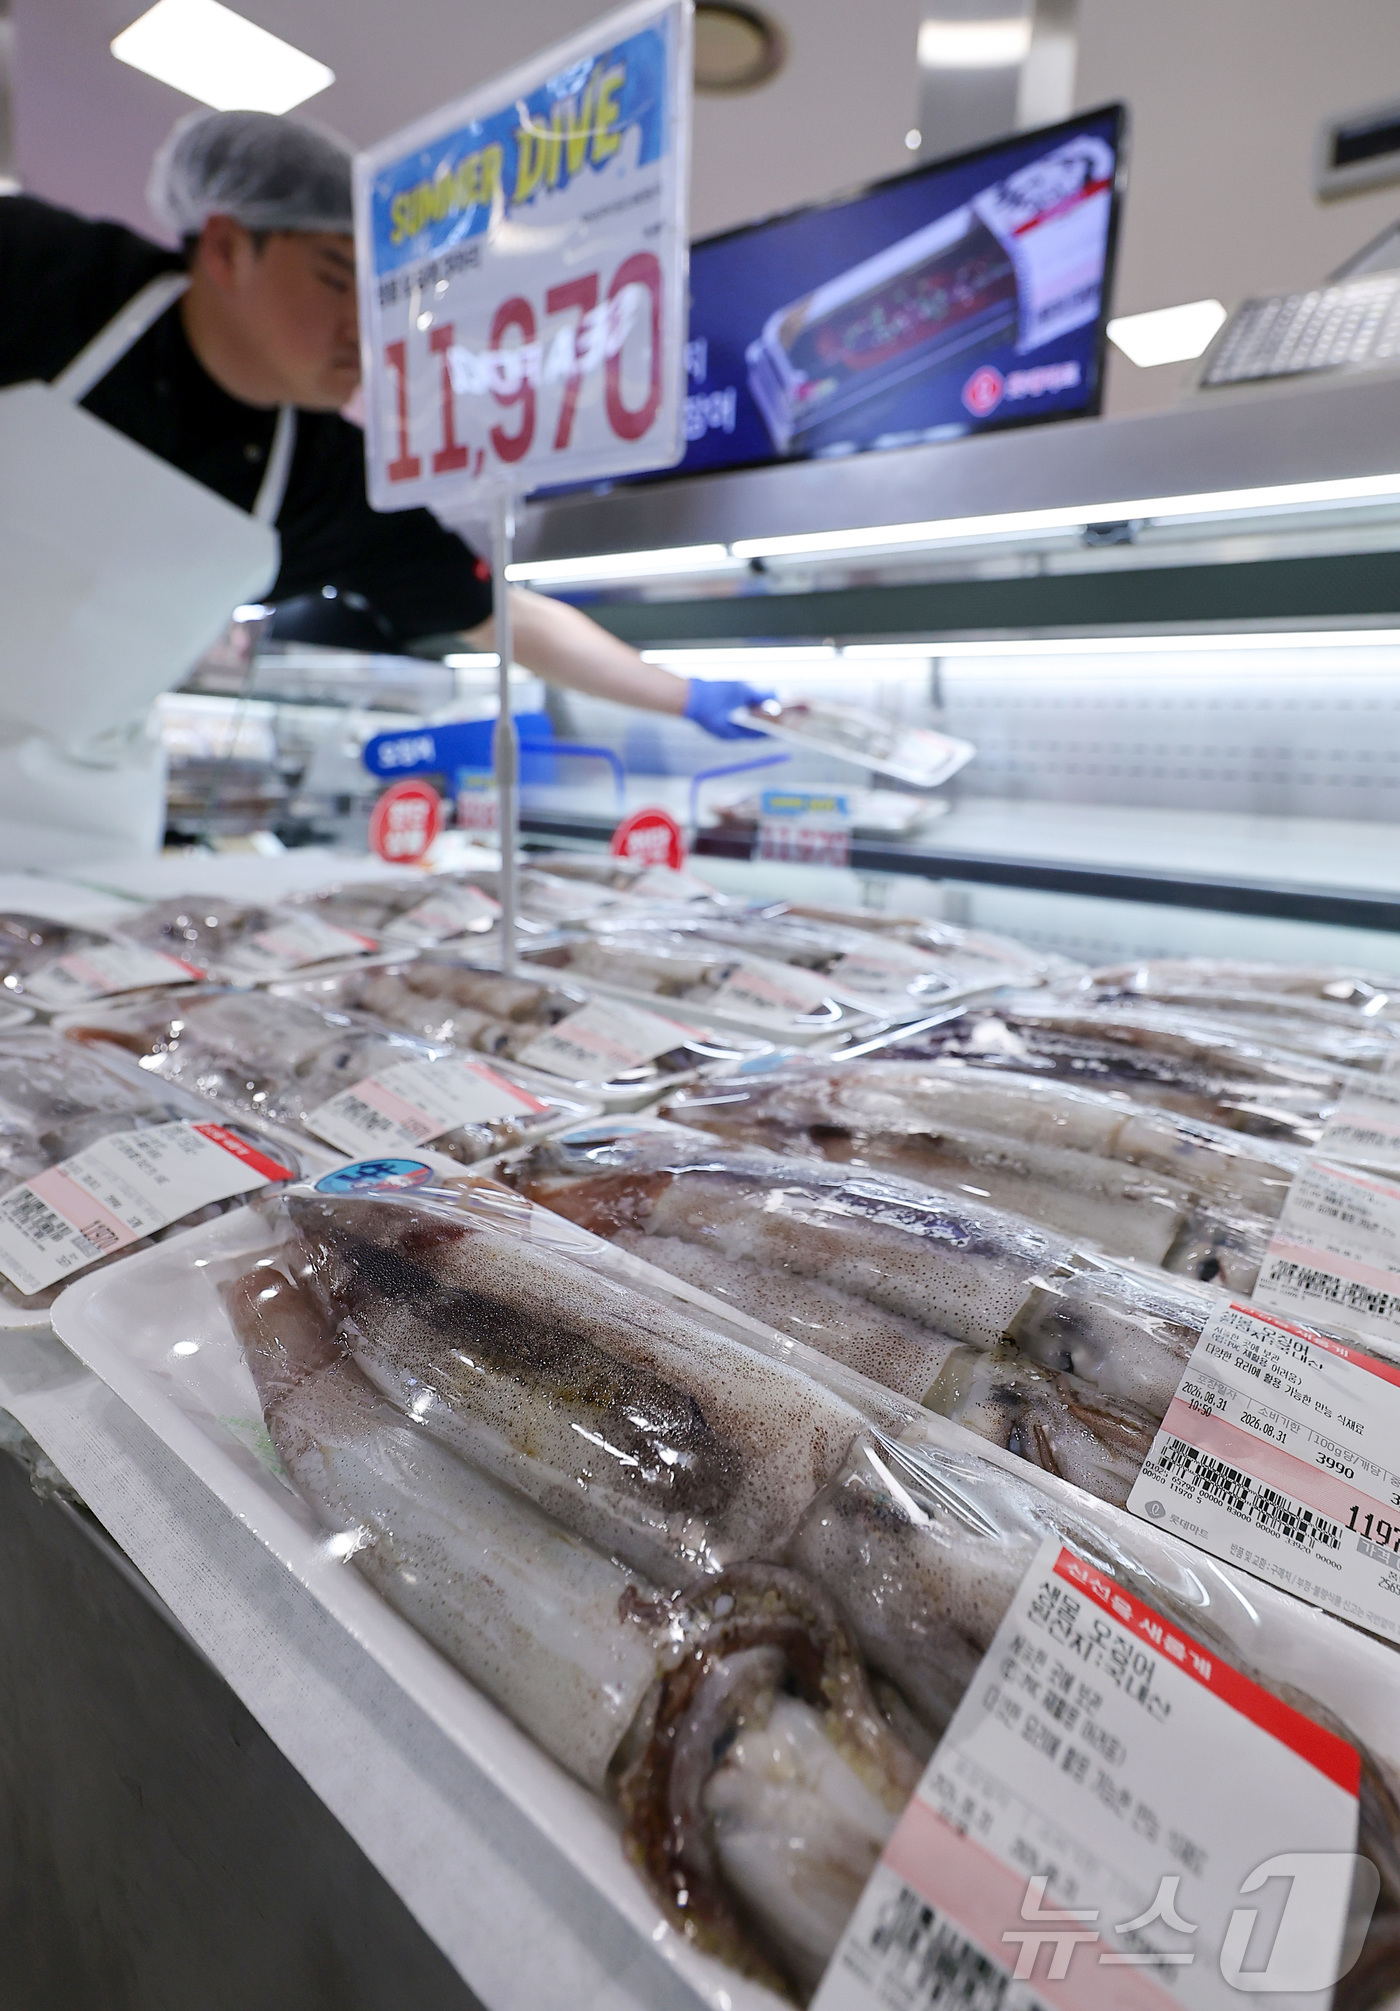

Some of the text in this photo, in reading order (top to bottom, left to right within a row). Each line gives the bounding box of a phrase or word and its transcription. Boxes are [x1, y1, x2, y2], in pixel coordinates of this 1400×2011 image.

[390, 62, 627, 246] SUMMER DIVE
[385, 251, 662, 483] 11,970
[1187, 1398, 1213, 1418] 10:50
[1205, 1342, 1365, 1437] 다양한 요리에 활용 가능한 만능 식재료
[1242, 1349, 1268, 1368] 재활용
[1271, 1363, 1303, 1386] 어려움)
[1181, 1381, 1228, 1412] 2026.08.31
[1240, 1410, 1287, 1444] 2026.08.31
[1315, 1450, 1355, 1479] 3990
[1196, 1375, 1238, 1401] 포장일자
[1257, 1406, 1301, 1435] 소비기한
[1313, 1433, 1382, 1477] 100g당/개당
[1142, 1468, 1166, 1485] 00000
[1169, 1482, 1193, 1500] 11970
[1145, 1460, 1169, 1478] 01025
[1171, 1475, 1196, 1493] 65790
[1198, 1489, 1224, 1507] 00000
[1226, 1505, 1252, 1523] 83000
[1255, 1521, 1281, 1539] 00000
[1315, 1552, 1342, 1571] 00000
[1169, 1513, 1209, 1541] 롯데마트
[1229, 1542, 1245, 1560] 반품
[1038, 1581, 1156, 1687] 생물 오징어
[1066, 1561, 1213, 1682] 신선을 새롭게
